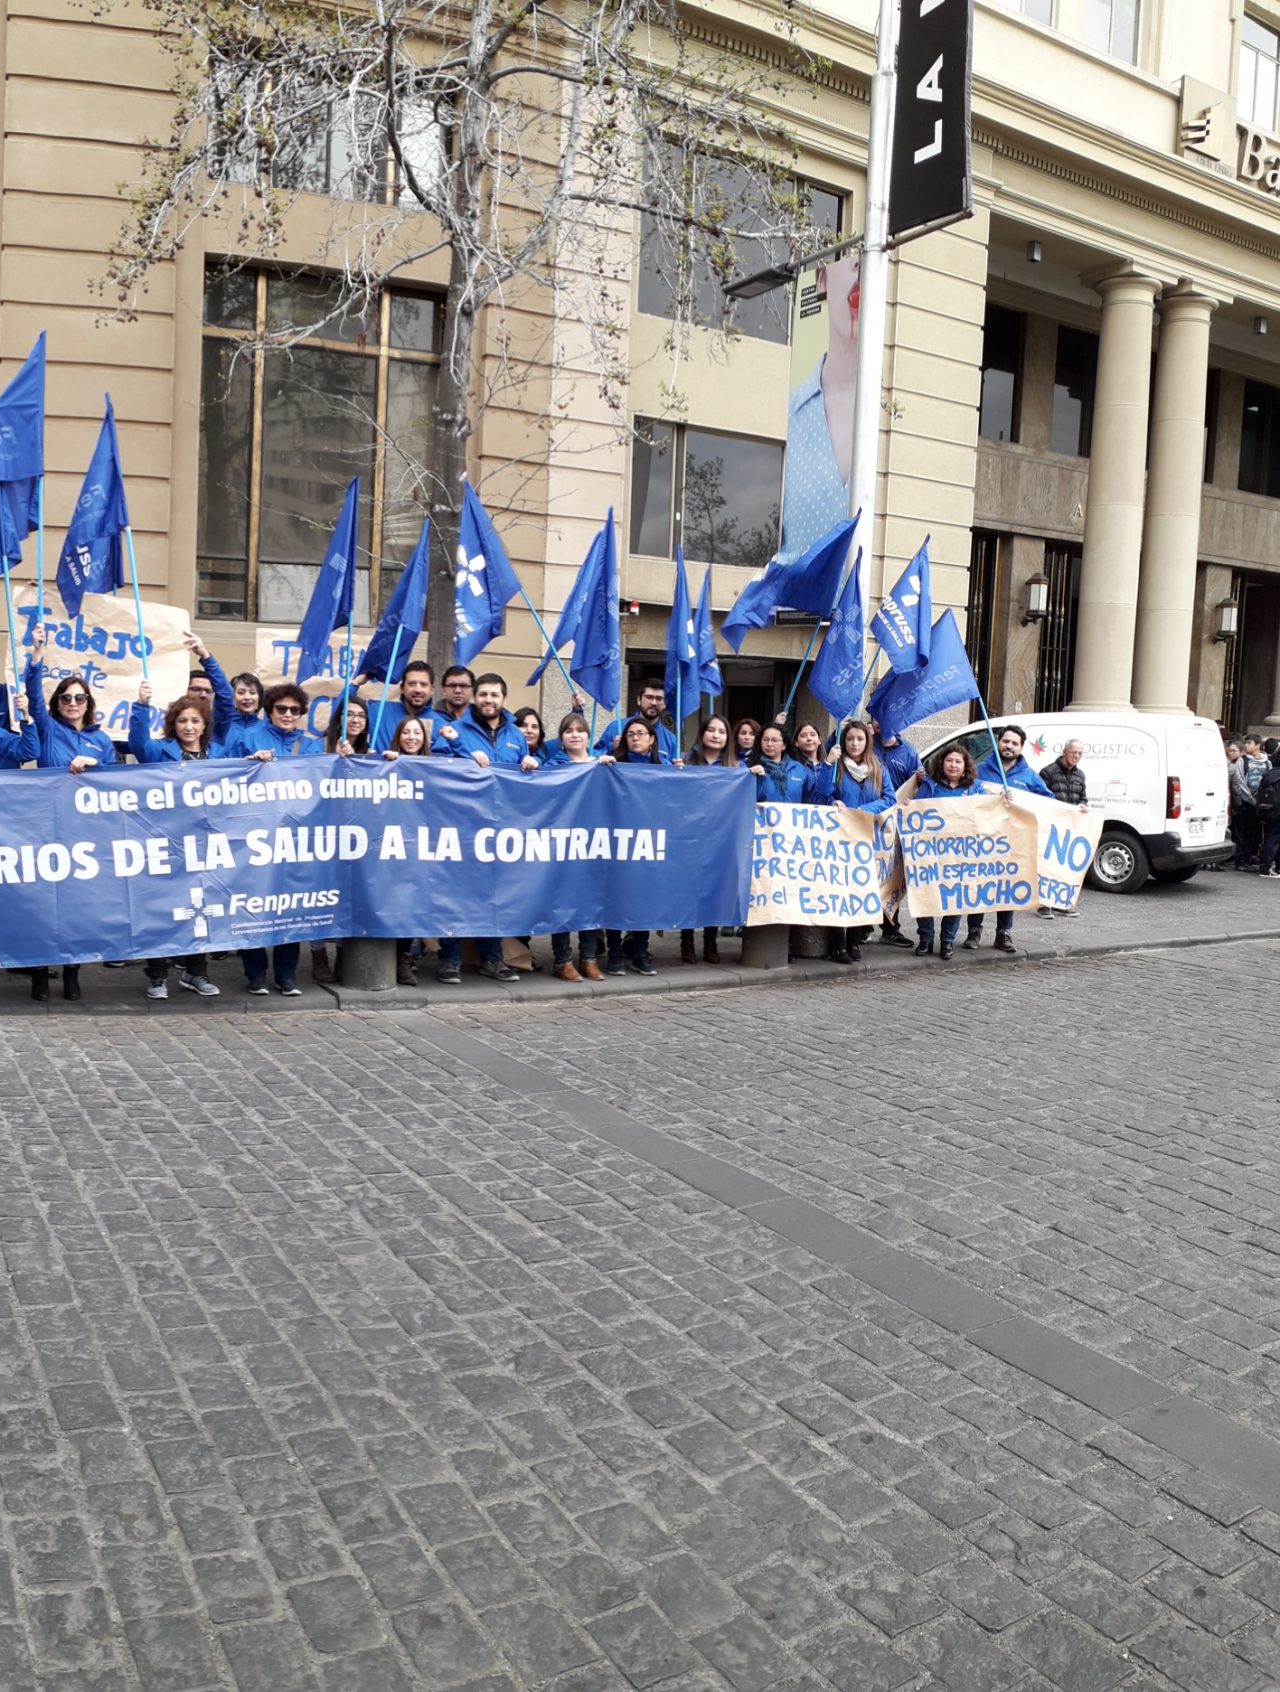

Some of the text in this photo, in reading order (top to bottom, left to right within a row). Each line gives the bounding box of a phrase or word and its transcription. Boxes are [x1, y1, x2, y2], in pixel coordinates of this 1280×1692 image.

[1080, 743, 1146, 756] OGISTICS
[74, 772, 424, 815] Que el Gobierno cumpla:
[897, 808, 946, 835] LOS
[111, 837, 172, 878] DE
[184, 833, 236, 872] LA
[246, 825, 369, 867] SALUD
[379, 825, 419, 861] A
[418, 827, 463, 862] LA
[473, 828, 666, 863] CONTRATA!
[753, 832, 873, 865] TRABAJO
[1043, 823, 1092, 873] NO
[752, 856, 871, 887] PRECARIO
[229, 889, 341, 916] Fenpruss
[772, 886, 787, 905] el
[938, 880, 1033, 911] MUCHO
